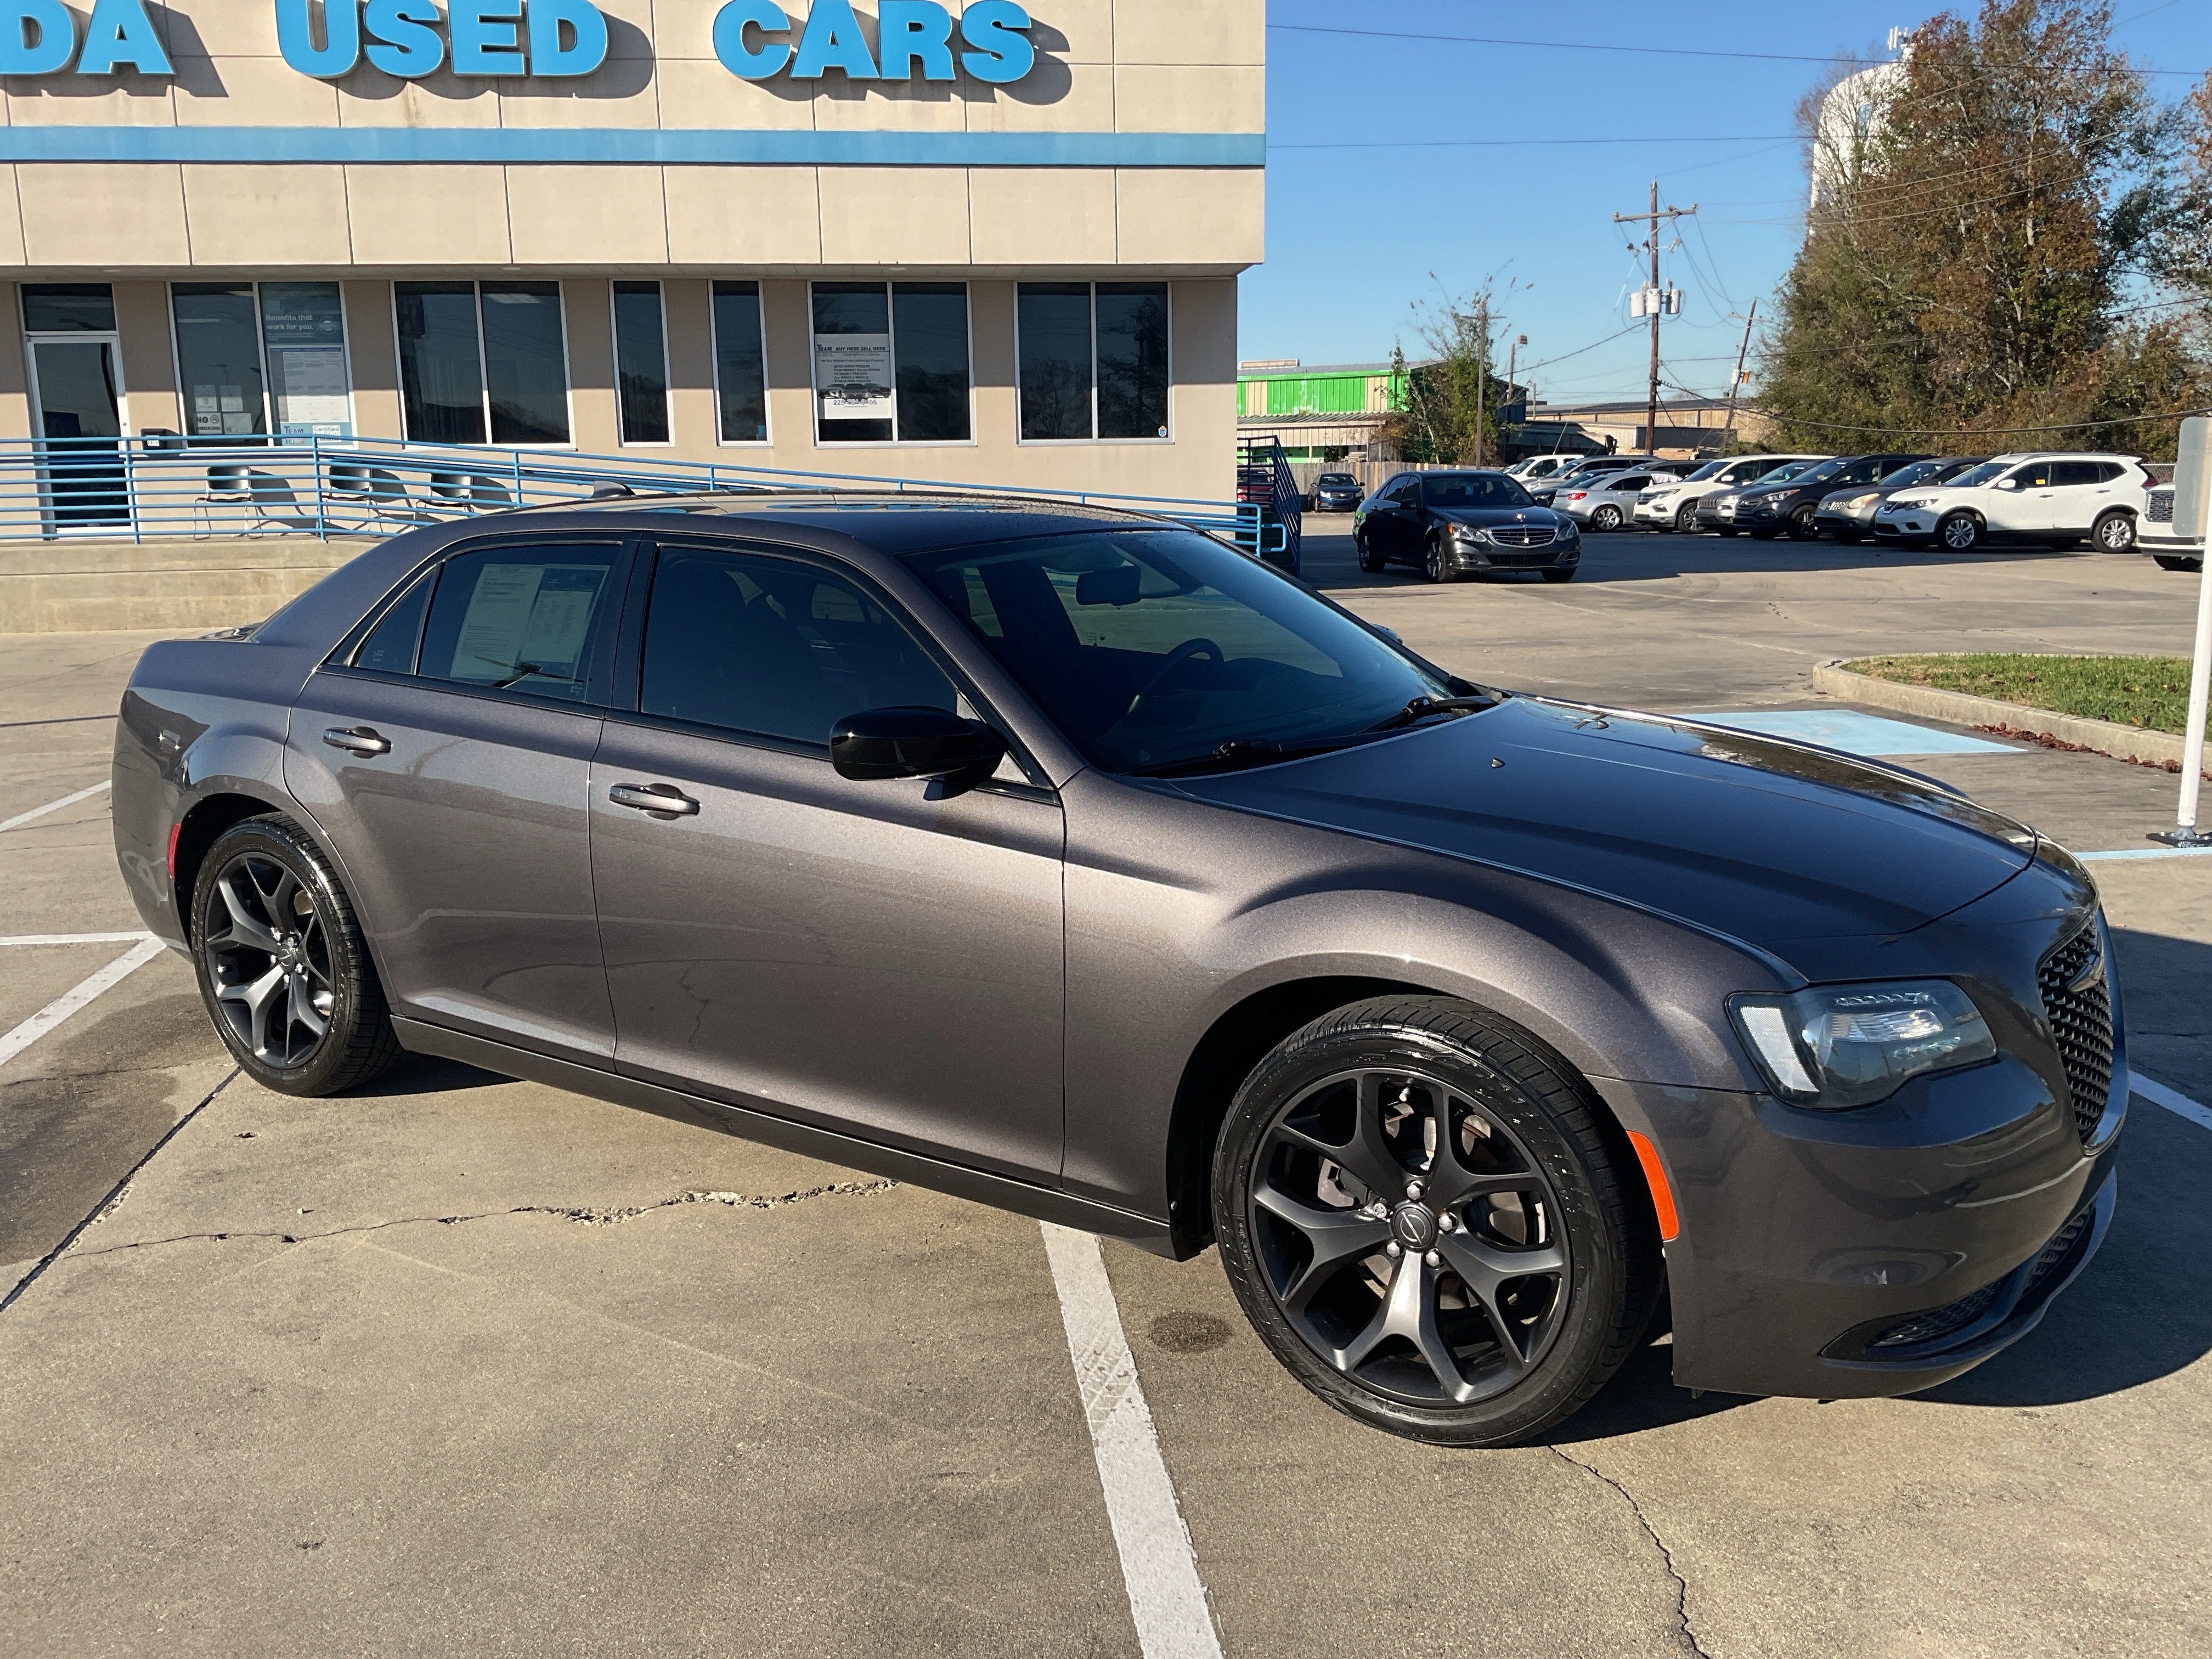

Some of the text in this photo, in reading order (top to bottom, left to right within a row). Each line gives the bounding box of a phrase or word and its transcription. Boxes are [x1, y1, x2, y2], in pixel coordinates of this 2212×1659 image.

[275, 0, 607, 78] USED
[713, 0, 1034, 83] CARS
[284, 426, 303, 434] TEAM
